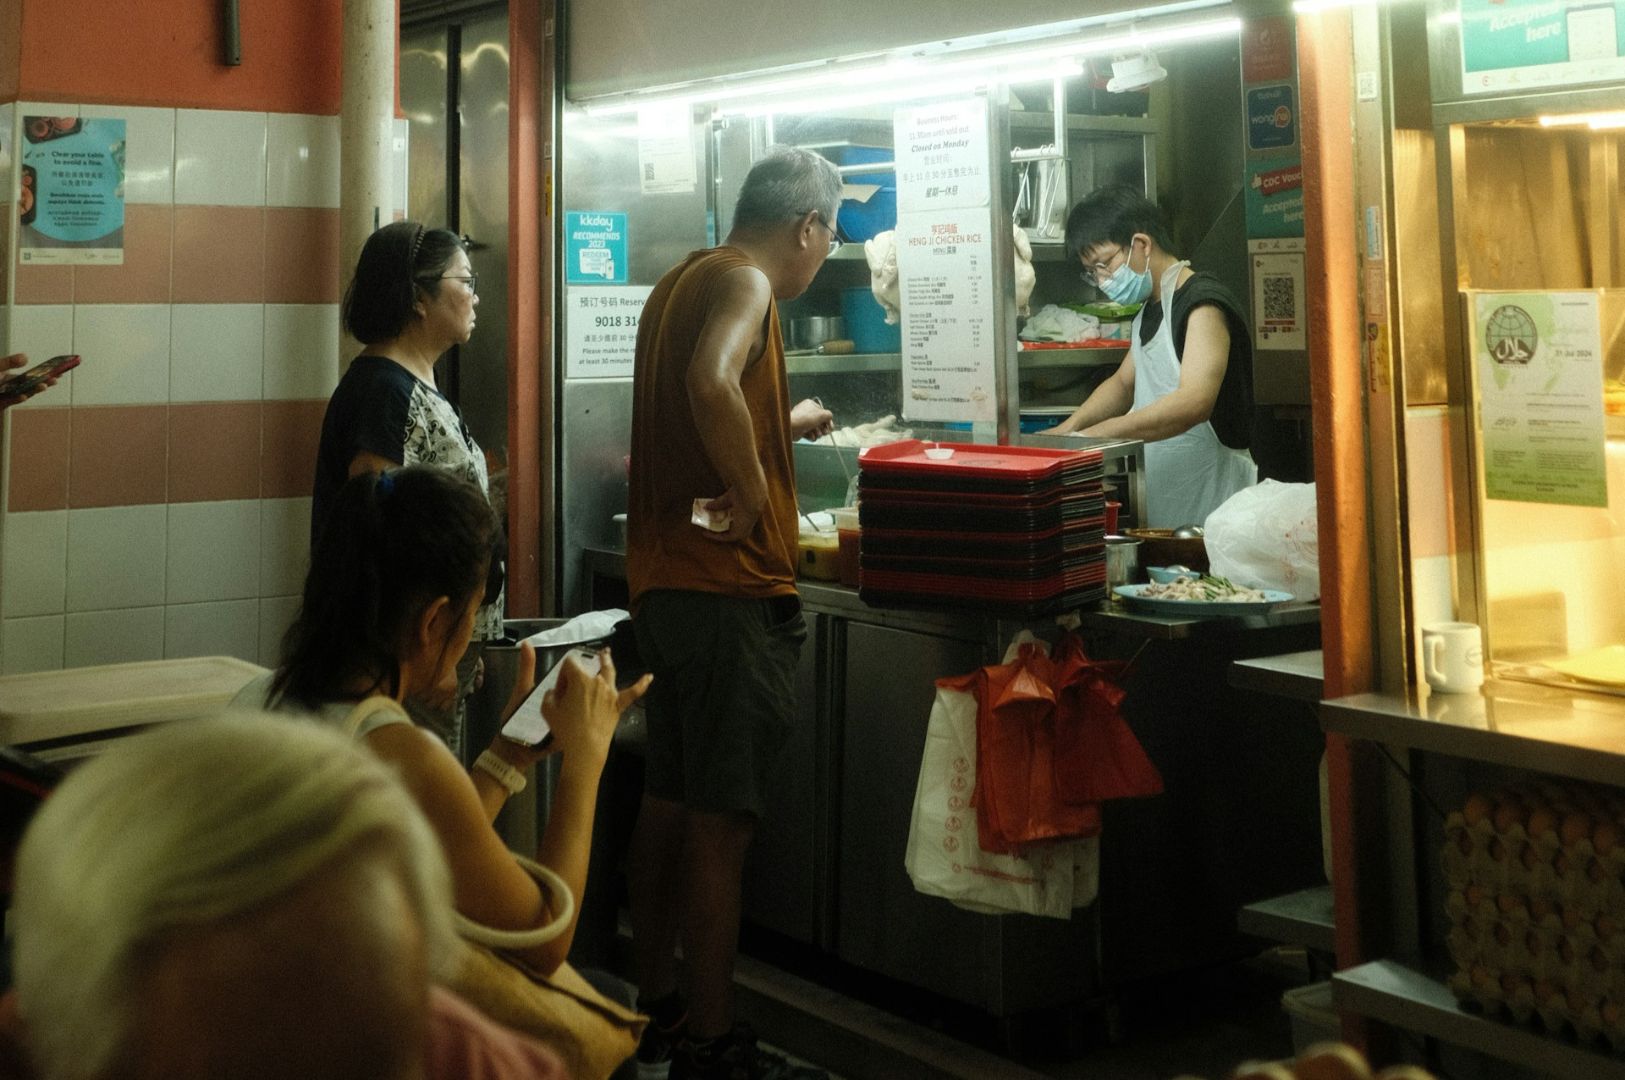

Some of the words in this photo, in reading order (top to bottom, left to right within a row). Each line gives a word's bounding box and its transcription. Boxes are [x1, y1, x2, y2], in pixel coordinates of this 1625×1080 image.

[1526, 21, 1561, 43] here
[911, 142, 933, 153] Closed
[942, 139, 969, 149] Monday
[1263, 176, 1281, 188] CDC
[1282, 172, 1302, 183] Vouc
[580, 214, 613, 232] kkday
[573, 231, 620, 240] RECOMMENDS
[908, 237, 927, 247] HENG
[935, 234, 965, 245] CHICKEN
[966, 233, 983, 243] RICE
[580, 297, 618, 308] 预订号码
[619, 298, 646, 307] Reserv
[595, 316, 622, 327] 9018
[625, 316, 640, 327] 31
